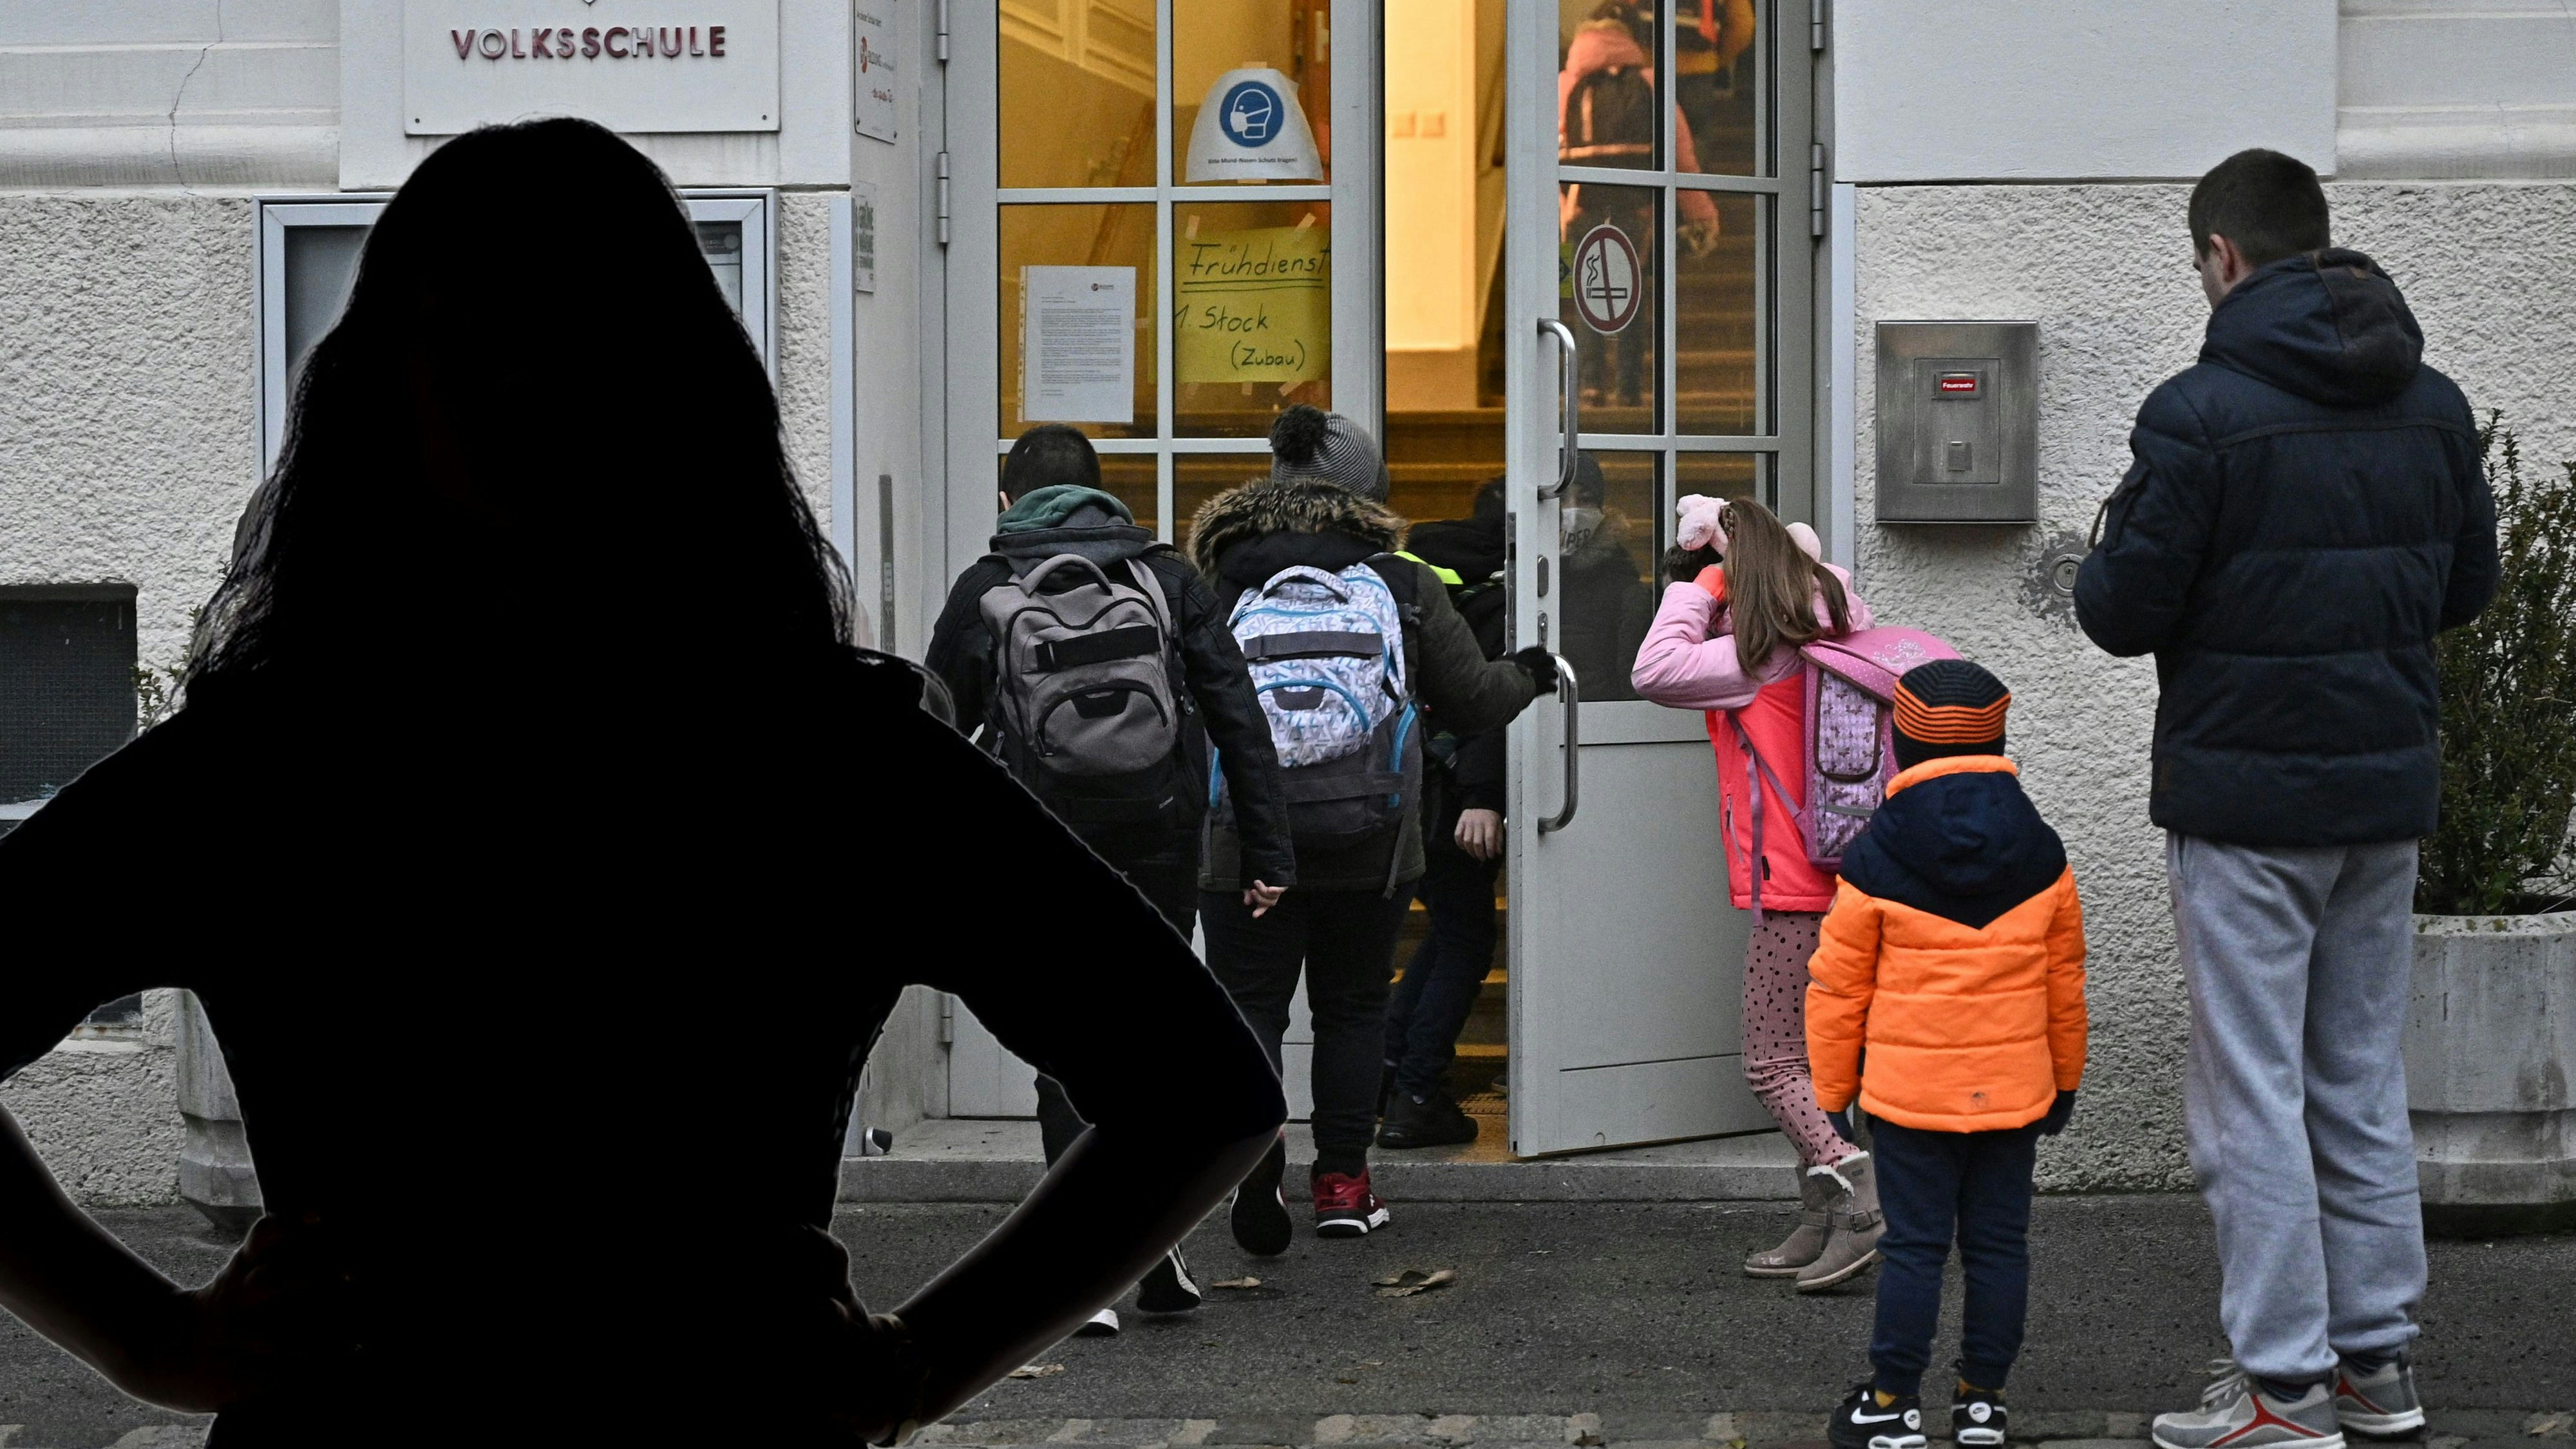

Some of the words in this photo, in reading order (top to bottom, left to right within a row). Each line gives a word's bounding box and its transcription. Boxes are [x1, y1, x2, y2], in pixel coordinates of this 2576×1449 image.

[451, 26, 726, 59] VOLKSSCHULE
[1189, 242, 1331, 276] Frühdienst
[1198, 303, 1268, 332] Stock
[1231, 339, 1305, 372] (Zubau)
